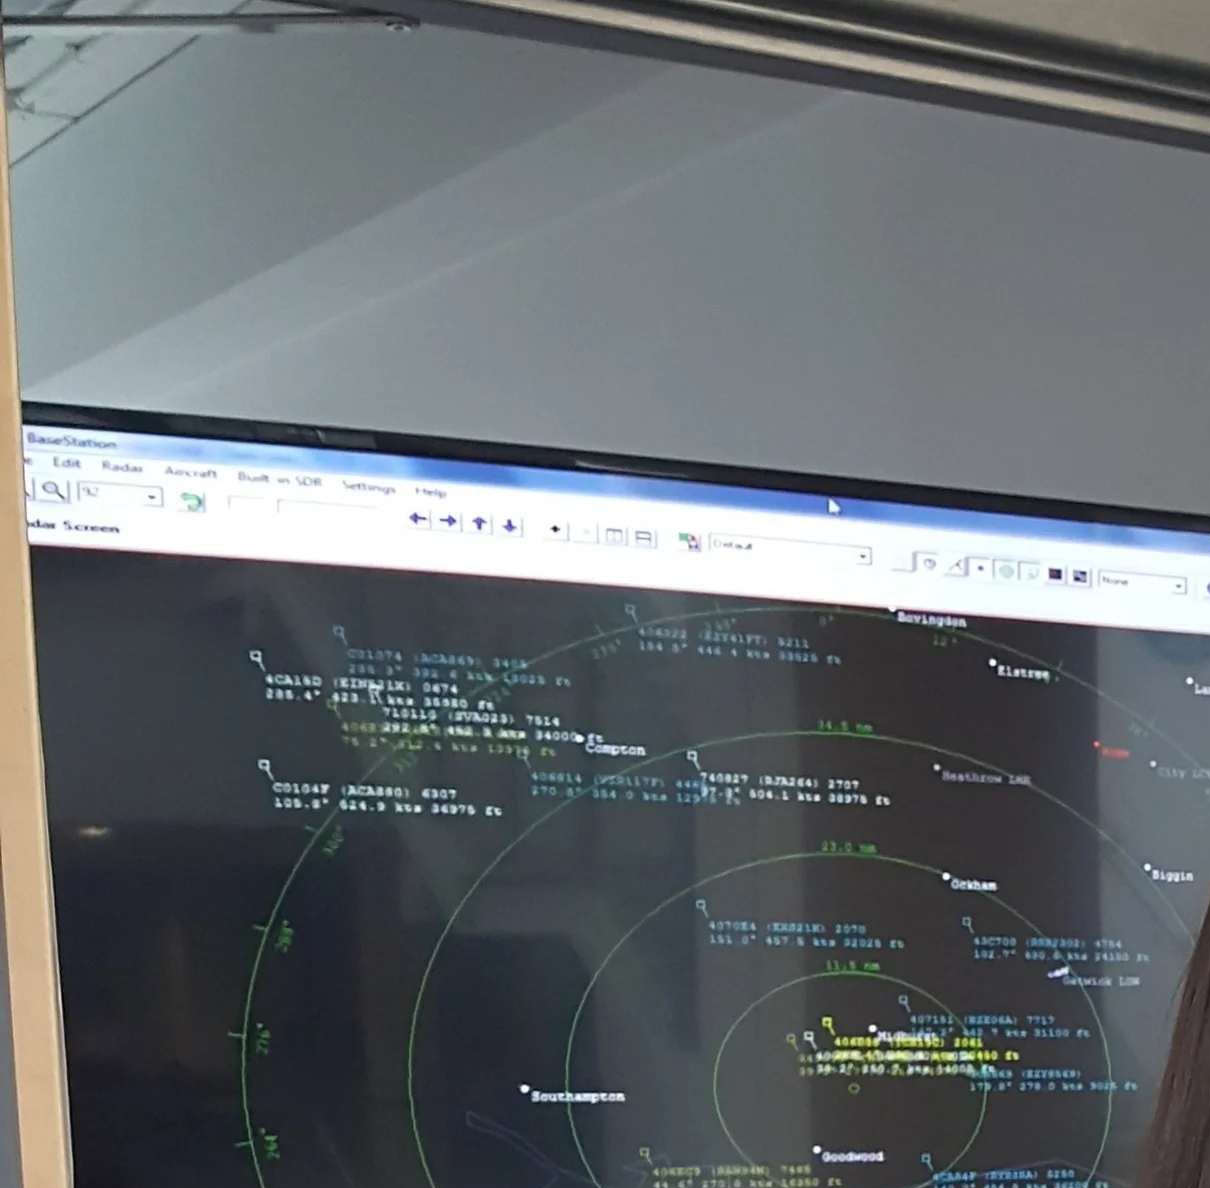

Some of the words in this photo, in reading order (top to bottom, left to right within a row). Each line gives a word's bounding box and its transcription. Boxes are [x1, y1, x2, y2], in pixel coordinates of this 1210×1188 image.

[27, 431, 118, 449] BaseStation
[53, 456, 82, 470] Edit
[102, 460, 144, 473] Radar
[585, 743, 647, 757] Compton
[1153, 869, 1194, 884] Biggin
[950, 879, 998, 892] Ockham
[531, 1090, 626, 1105] Southampton
[822, 1150, 884, 1163] Goodwood
